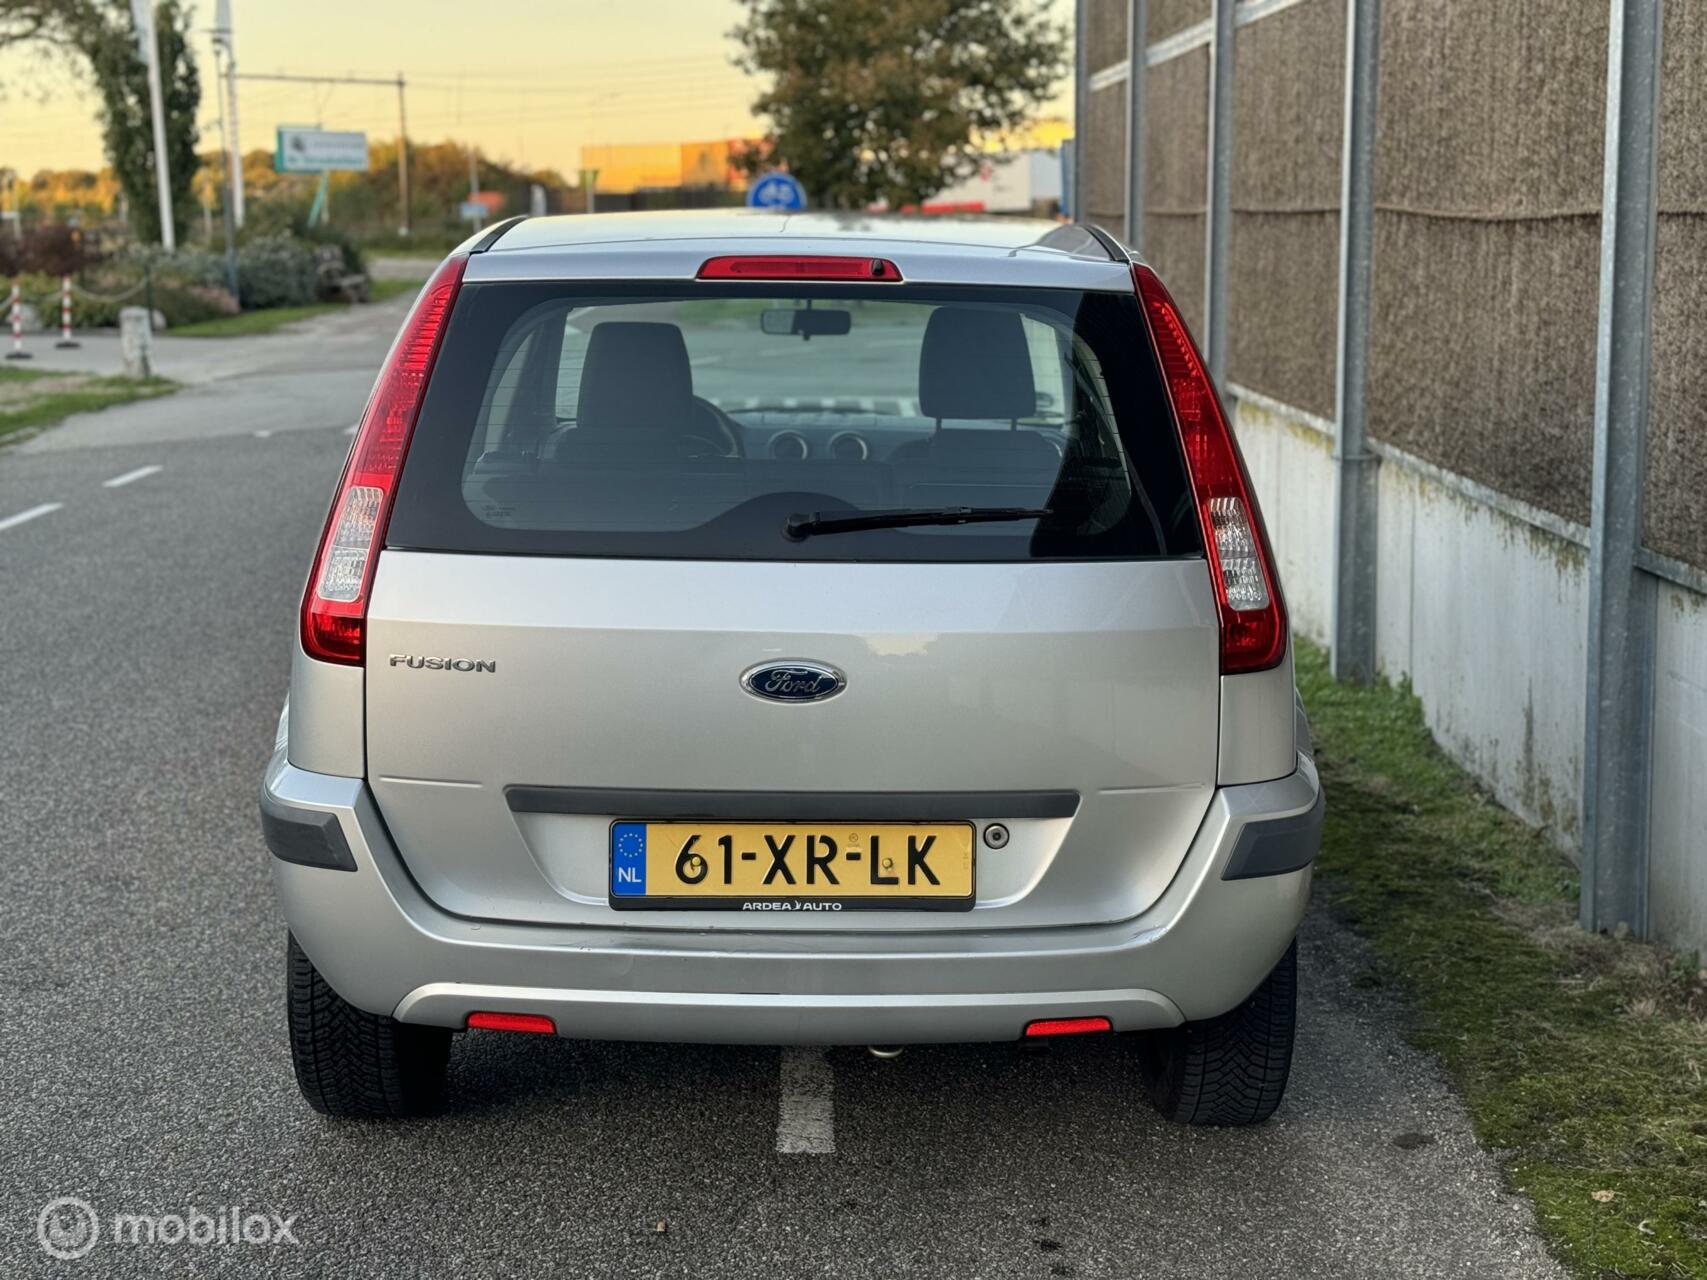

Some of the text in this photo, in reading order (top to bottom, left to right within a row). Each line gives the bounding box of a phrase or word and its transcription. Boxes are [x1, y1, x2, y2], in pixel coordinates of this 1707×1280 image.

[389, 654, 496, 673] FUSION
[764, 669, 822, 693] Ford
[675, 835, 940, 885] 61-XR-LK
[618, 867, 642, 882] NL
[742, 902, 842, 911] ARDEA AUTO
